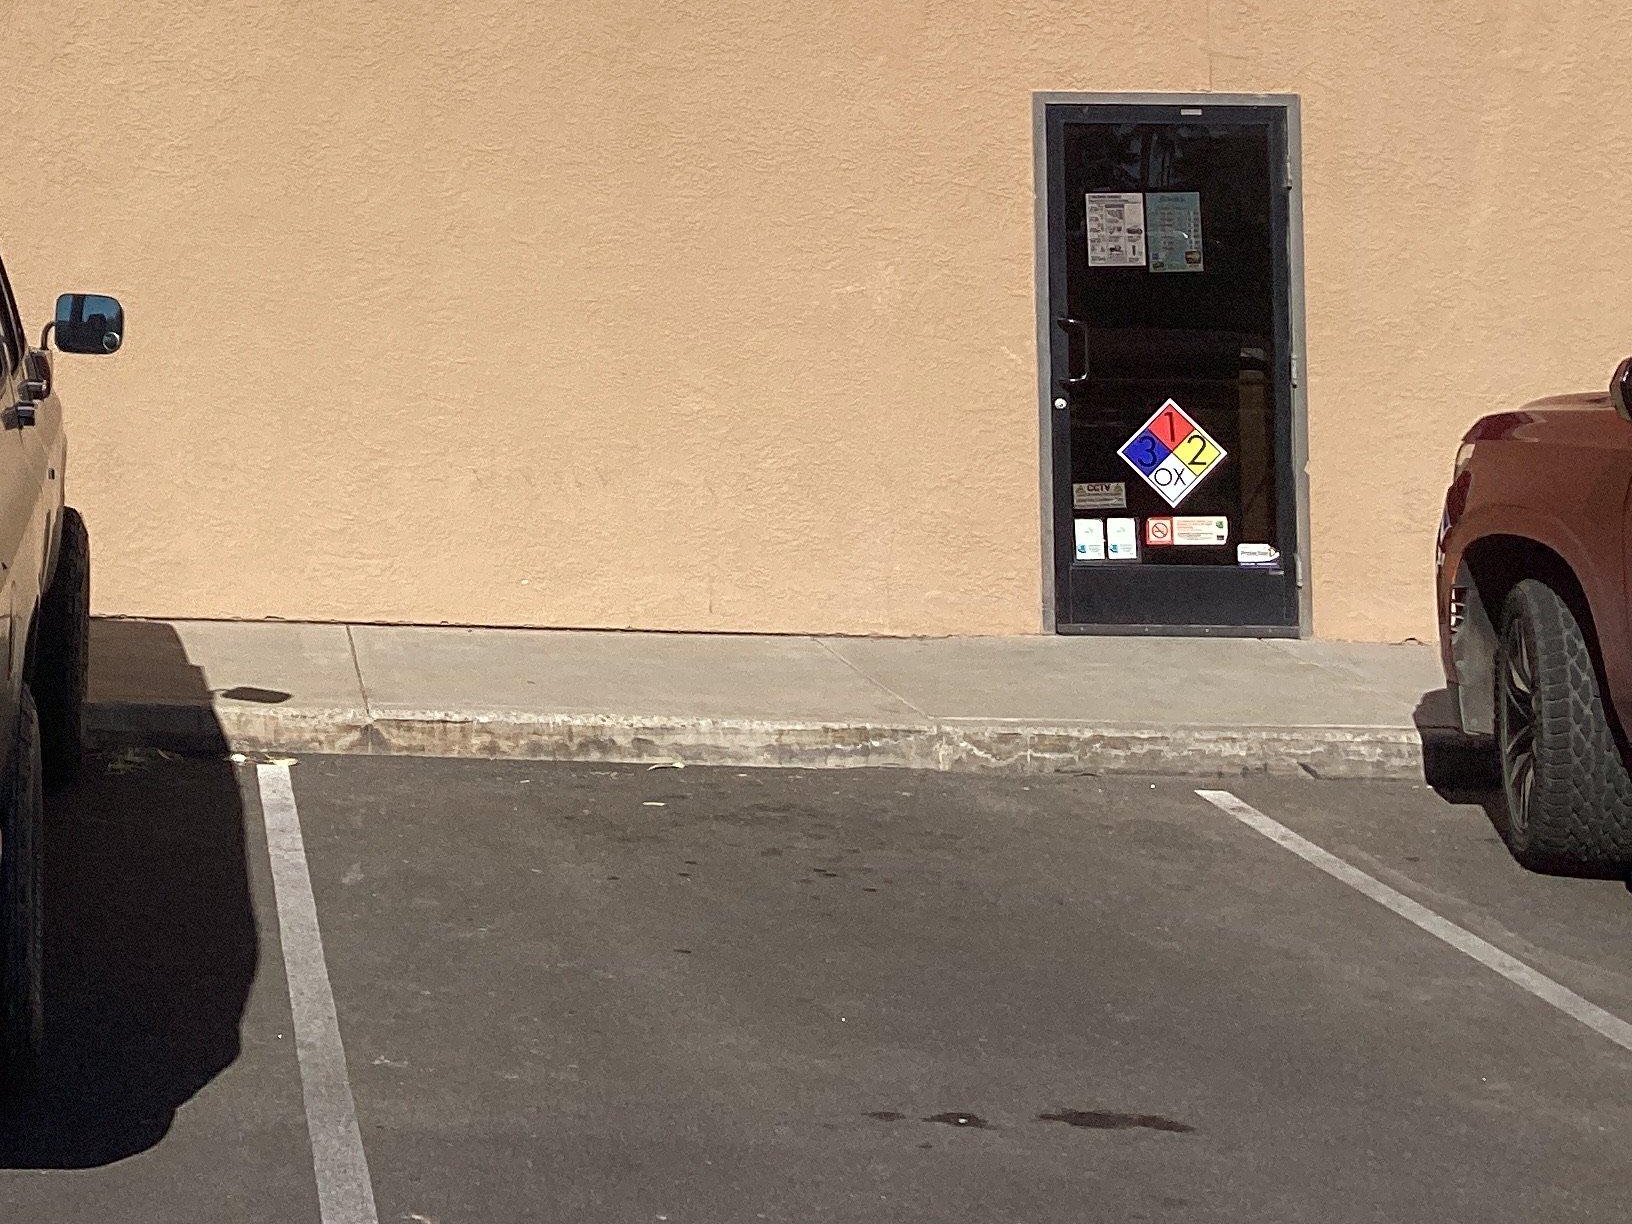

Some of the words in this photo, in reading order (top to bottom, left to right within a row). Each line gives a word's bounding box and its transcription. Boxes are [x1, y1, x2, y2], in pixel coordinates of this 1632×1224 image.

[1164, 412, 1175, 442] 1
[1138, 436, 1157, 467] 3
[1187, 435, 1206, 465] 2
[1154, 468, 1186, 486] OX
